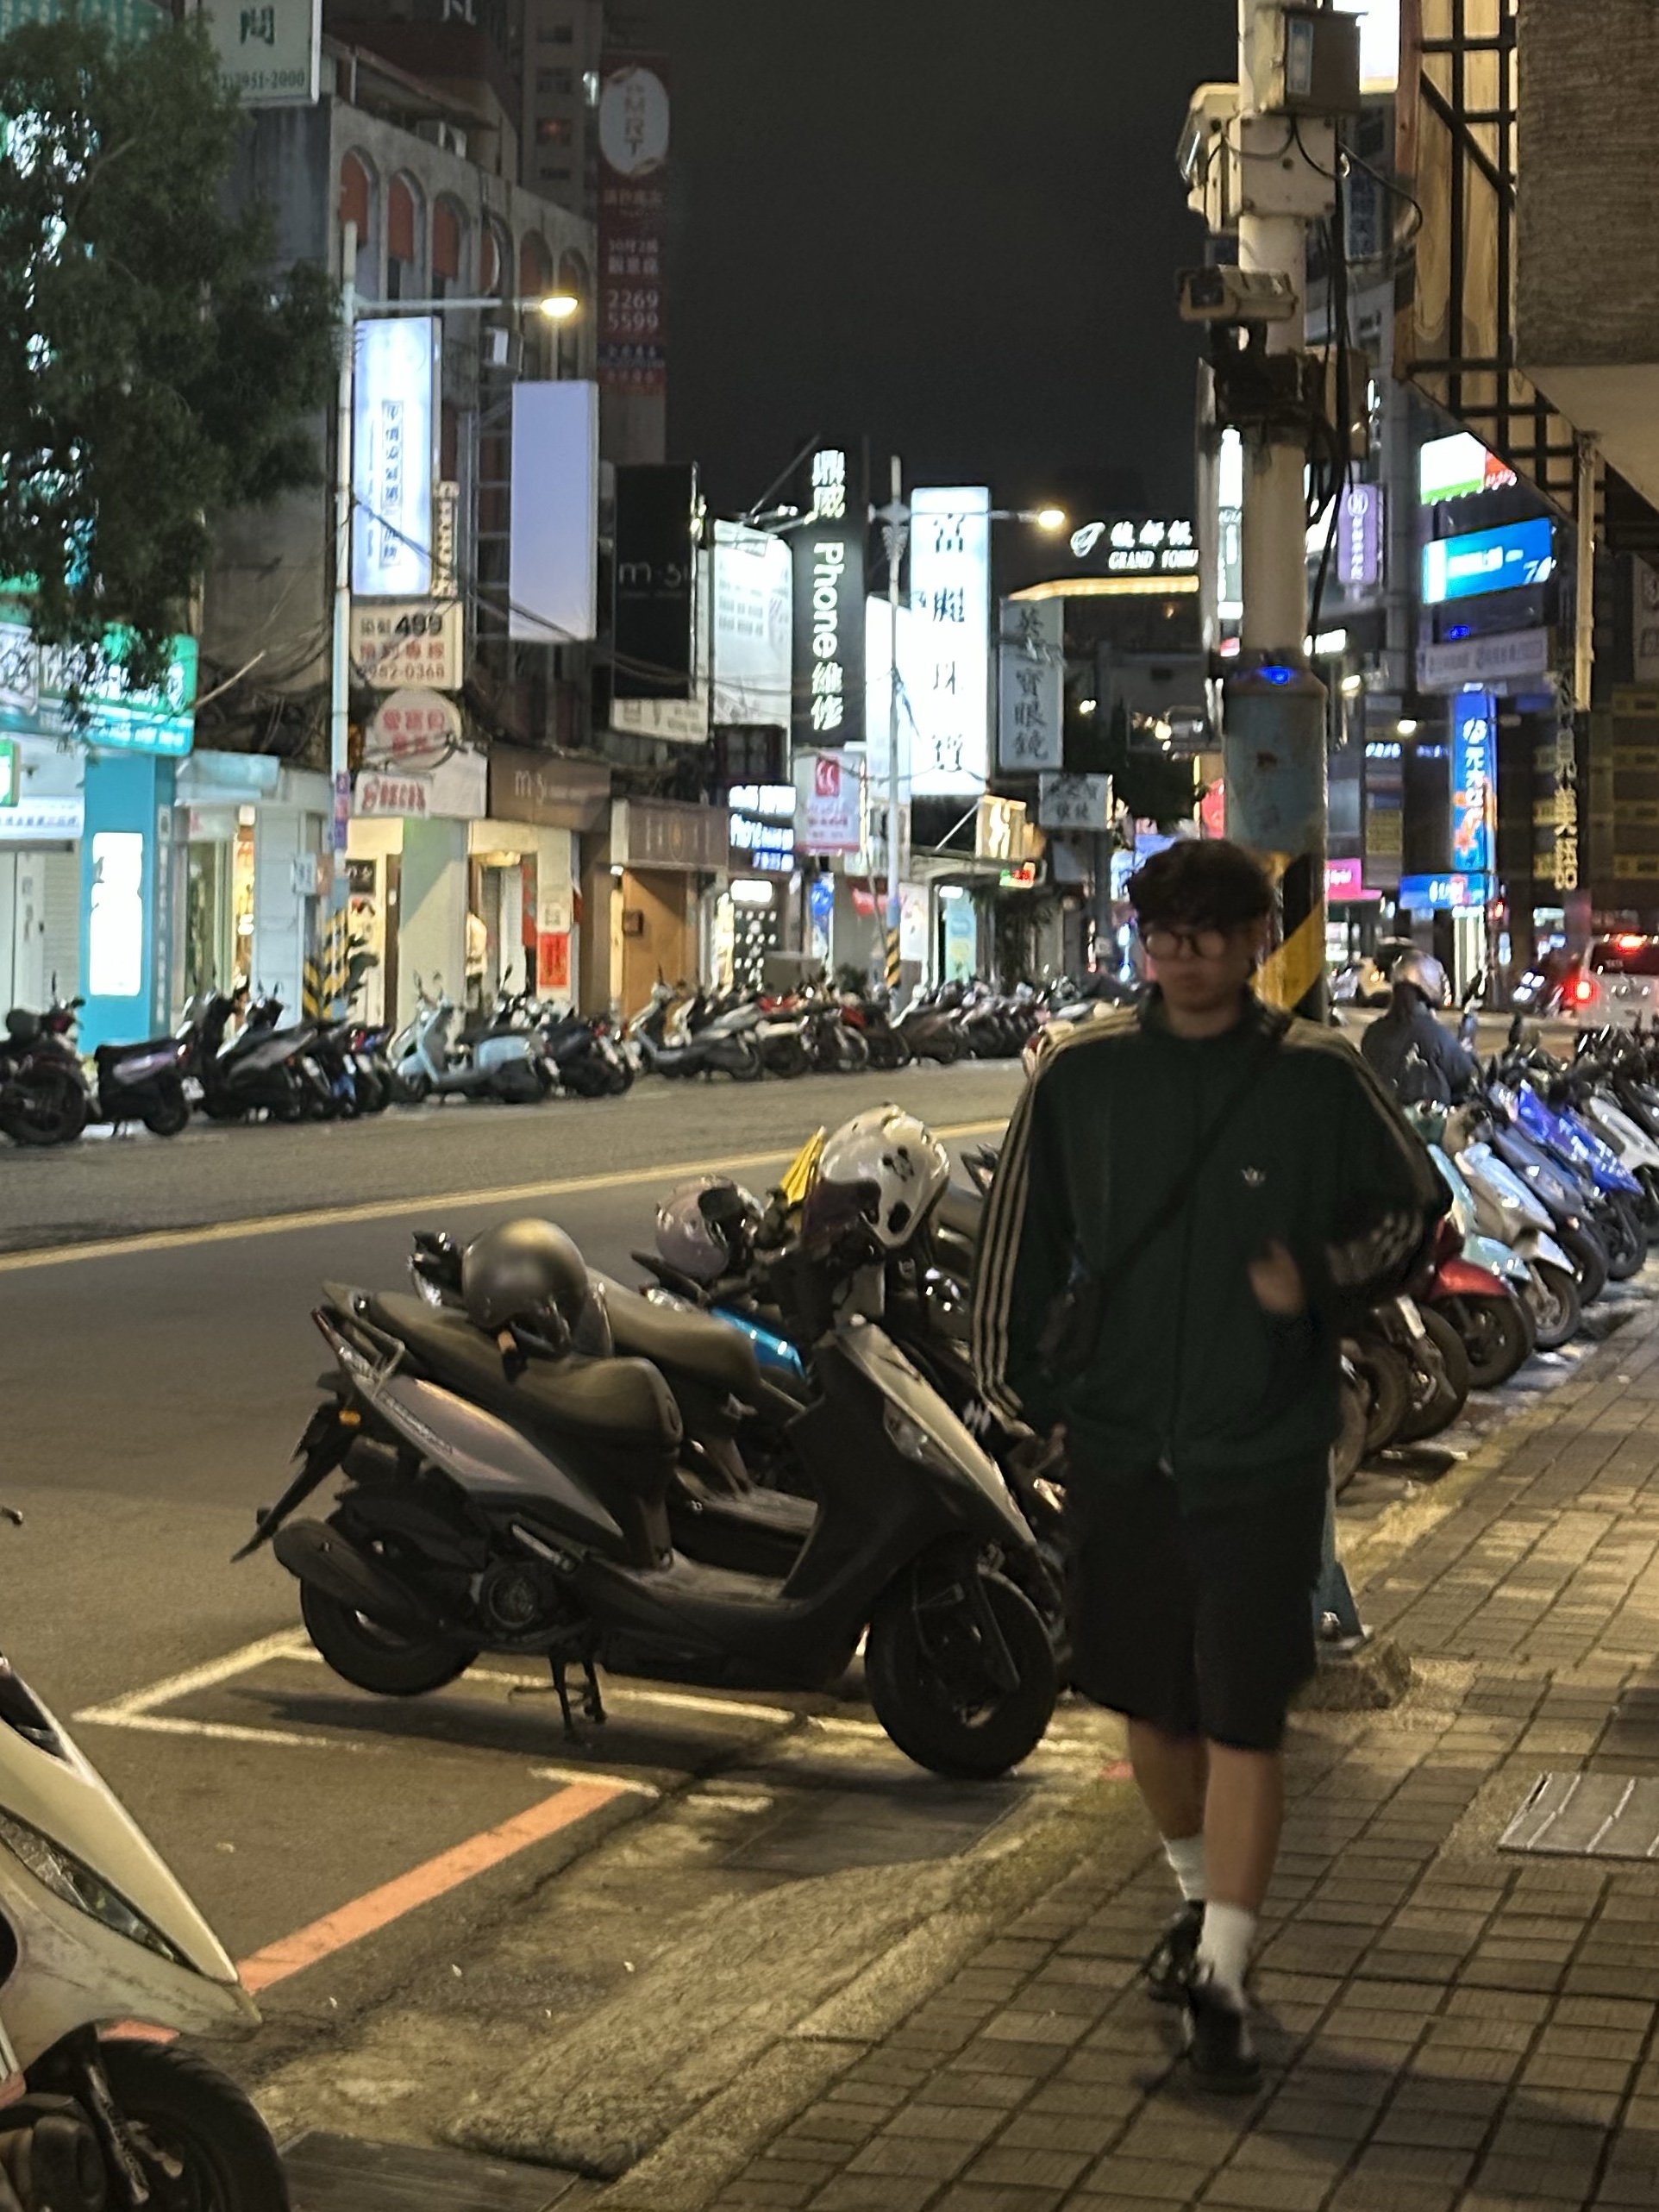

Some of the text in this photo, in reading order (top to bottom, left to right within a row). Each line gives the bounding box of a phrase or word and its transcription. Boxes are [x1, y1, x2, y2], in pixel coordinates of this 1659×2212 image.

[608, 289, 659, 310] 2269
[608, 311, 659, 331] 5599
[1109, 550, 1155, 570] GRAND
[812, 542, 845, 659] Phone
[395, 612, 443, 636] 499
